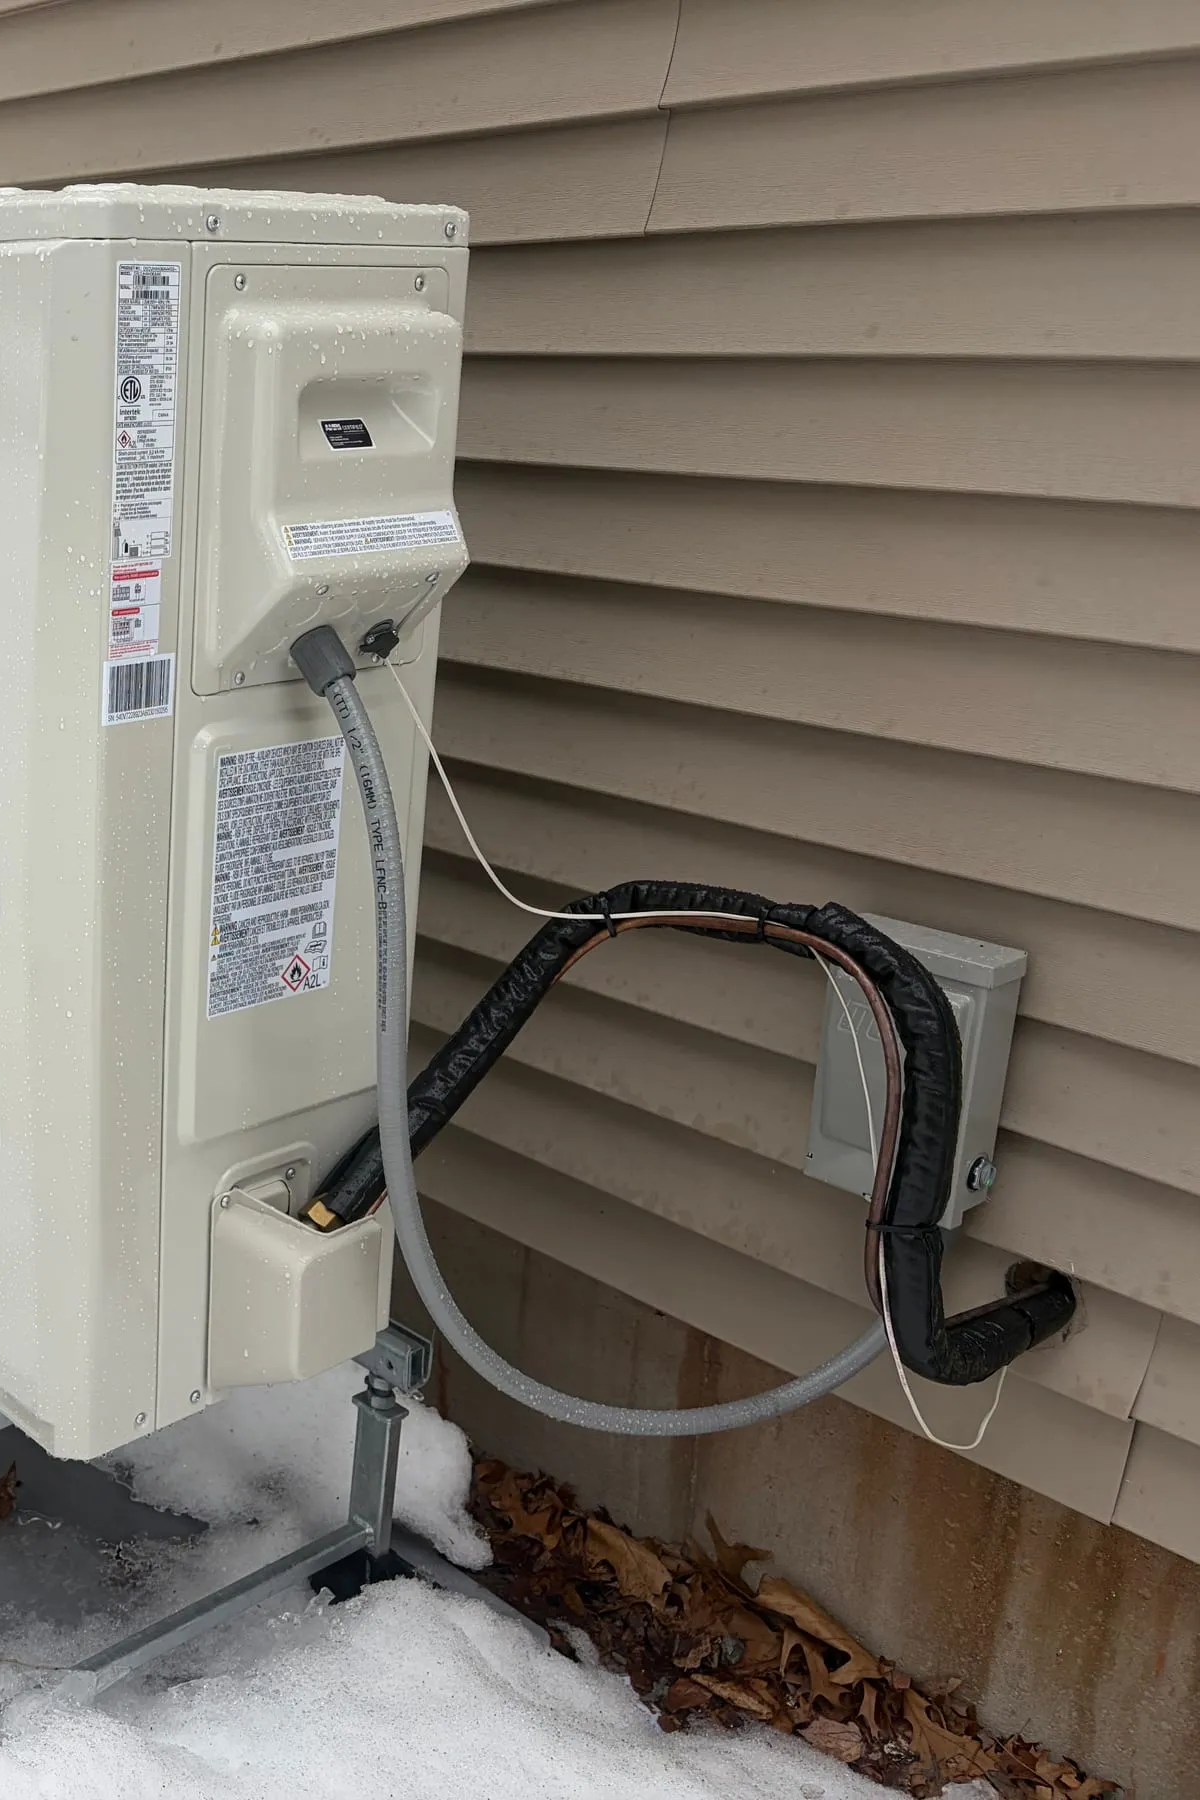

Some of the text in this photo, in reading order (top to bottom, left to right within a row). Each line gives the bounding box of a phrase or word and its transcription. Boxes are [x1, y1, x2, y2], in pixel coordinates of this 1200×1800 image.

[333, 693, 351, 719] (TT)
[347, 727, 364, 754] 1/2"
[359, 765, 377, 810] (16MM)
[370, 819, 384, 852] TYPE
[375, 860, 388, 910] LFNC-B
[303, 974, 321, 991] A2L
